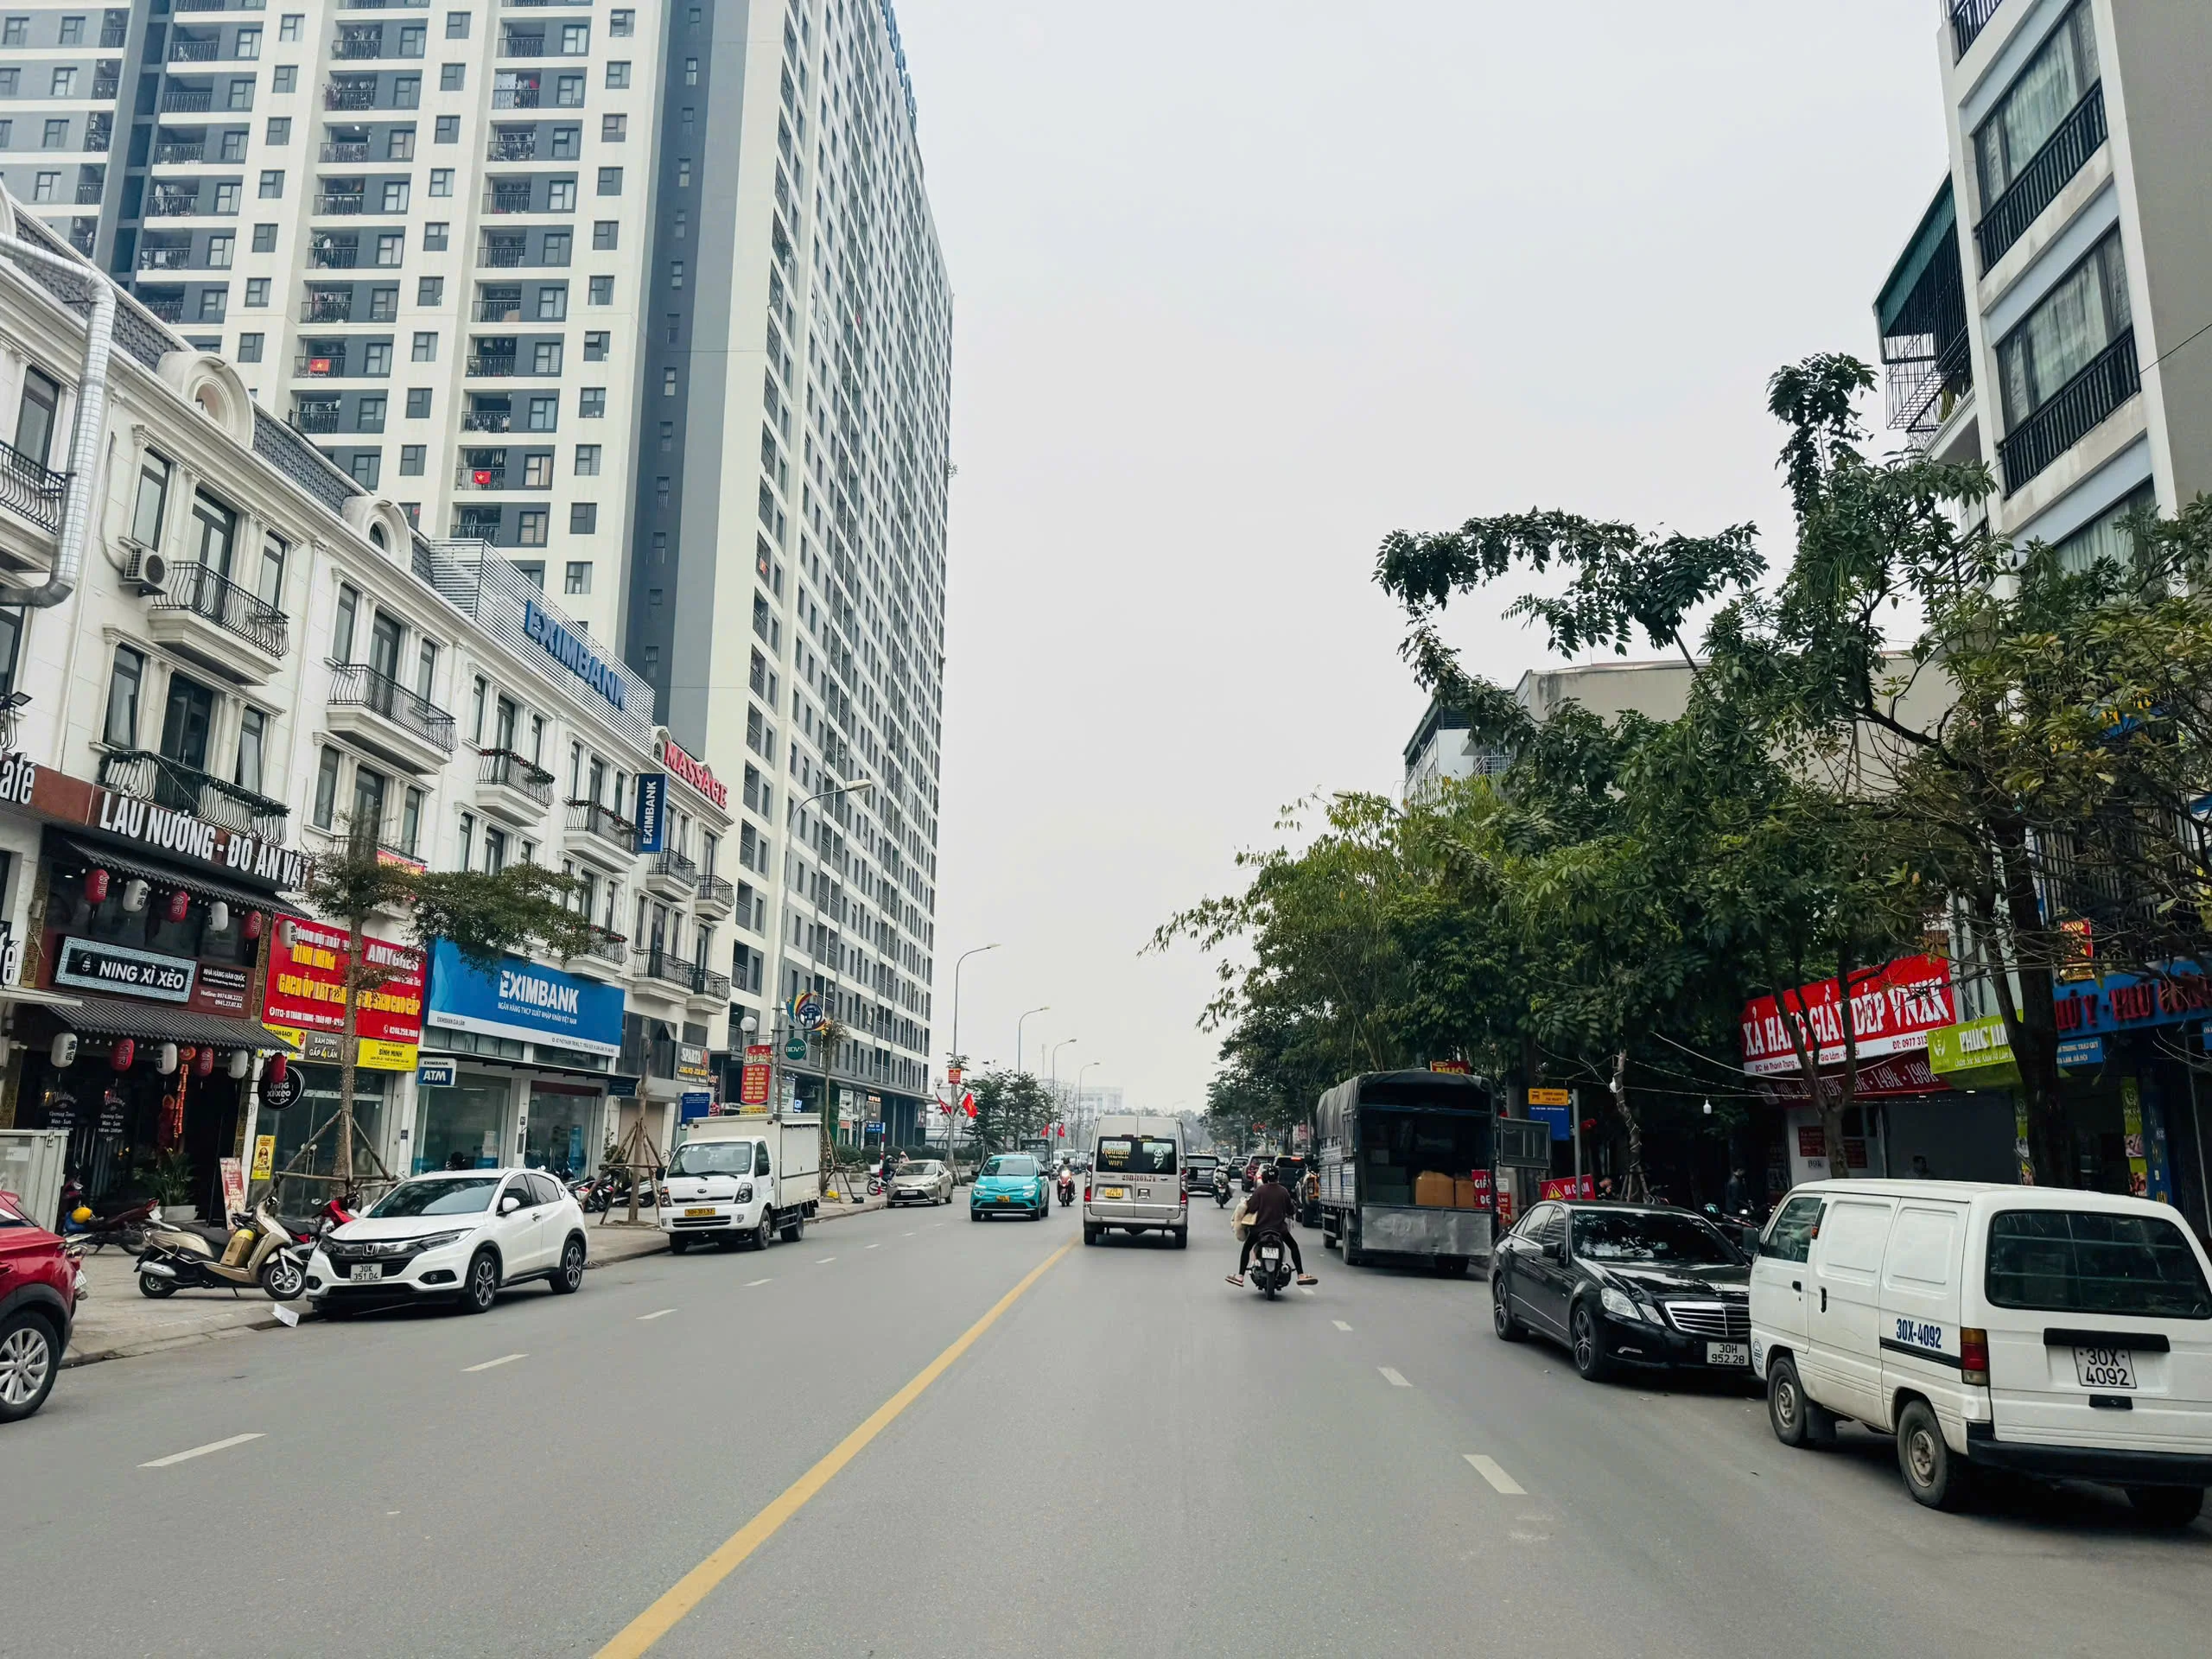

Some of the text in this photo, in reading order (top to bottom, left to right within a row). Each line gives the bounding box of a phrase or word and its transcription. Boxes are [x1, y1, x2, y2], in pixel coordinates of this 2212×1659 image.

[524, 599, 626, 711] EXIMBANK
[664, 741, 728, 810] MASSAGE
[643, 780, 657, 844] EXIMBANK
[145, 810, 216, 861] NƯỚNG
[99, 960, 138, 982] NING
[140, 964, 156, 985] XÌ
[156, 969, 184, 989] XÈO
[213, 969, 225, 978] HÀNG
[499, 969, 580, 1014] EXIMBANK
[1743, 1006, 1765, 1057] XẢ
[1764, 1004, 1807, 1052] HÀG
[1887, 976, 1949, 1028] VNXK
[1902, 1037, 1916, 1047] 0977
[321, 1046, 327, 1059] 4
[1820, 1053, 1829, 1062] Gia
[423, 1070, 446, 1081] ATM
[1872, 1065, 1904, 1090] 149k
[1906, 1060, 1940, 1086] 199k
[359, 1264, 372, 1273] 30K
[1896, 1318, 1942, 1349] 30X-4092
[1711, 1353, 1745, 1364] 952.28
[1719, 1344, 1738, 1354] 30H
[2087, 1347, 2120, 1367] 30X
[2086, 1366, 2130, 1386] 4092
